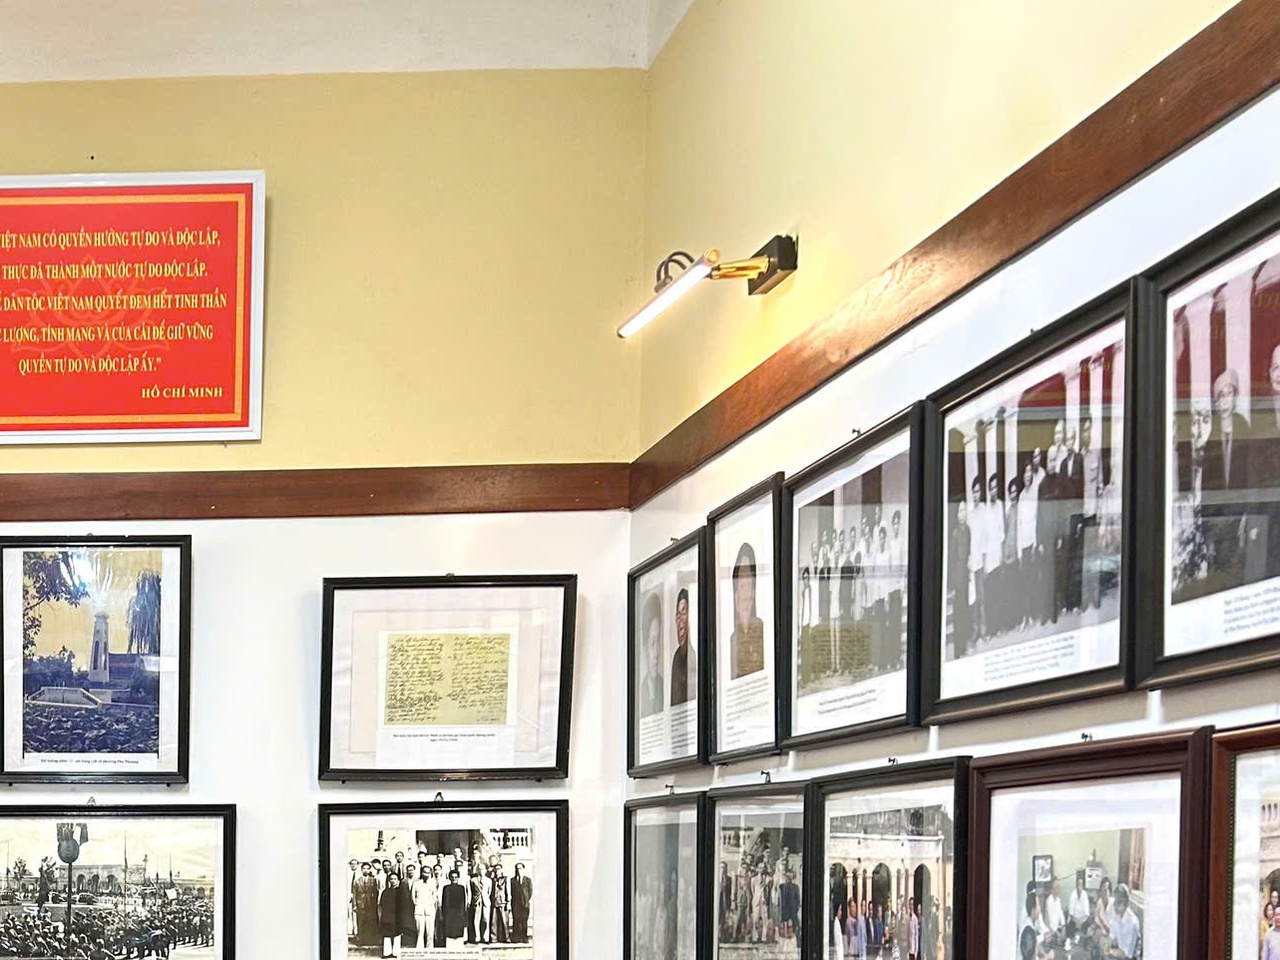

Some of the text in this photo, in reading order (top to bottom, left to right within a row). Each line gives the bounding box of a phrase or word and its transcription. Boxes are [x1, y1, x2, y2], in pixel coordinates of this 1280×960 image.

[19, 233, 42, 248] NAM
[43, 228, 57, 248] CÓ
[131, 229, 145, 249] TỰ
[145, 231, 160, 246] DO
[161, 226, 175, 246] VÀ
[176, 226, 197, 249] ĐỘC
[2, 263, 28, 283] THỰC
[30, 261, 44, 279] ĐÃ
[45, 260, 79, 279] THÀNH
[81, 259, 103, 282] MỘT
[104, 259, 132, 279] NƯỚC
[133, 261, 148, 280] TỰ
[148, 262, 163, 277] DO
[164, 259, 185, 281] ĐỘC
[3, 292, 24, 311] DÂN
[25, 292, 46, 314] TỘC
[46, 291, 69, 313] VIỆT
[71, 295, 93, 311] NAM
[95, 288, 129, 313] QUYẾT
[153, 287, 174, 310] HẾT
[174, 294, 198, 309] TINH
[41, 323, 65, 343] TÍNH
[66, 326, 95, 345] MẠNG
[96, 322, 110, 341] VÀ
[111, 321, 132, 341] CỦA
[133, 321, 151, 341] CẢI
[166, 322, 185, 340] GIỮ
[186, 321, 214, 340] VỮNG
[53, 355, 67, 376] TỰ
[68, 358, 82, 373] DO
[83, 354, 97, 372] VÀ
[98, 354, 119, 376] ĐỘC
[120, 353, 140, 376] LẬP
[162, 384, 186, 398] CHÍ
[188, 386, 223, 399] MINH
